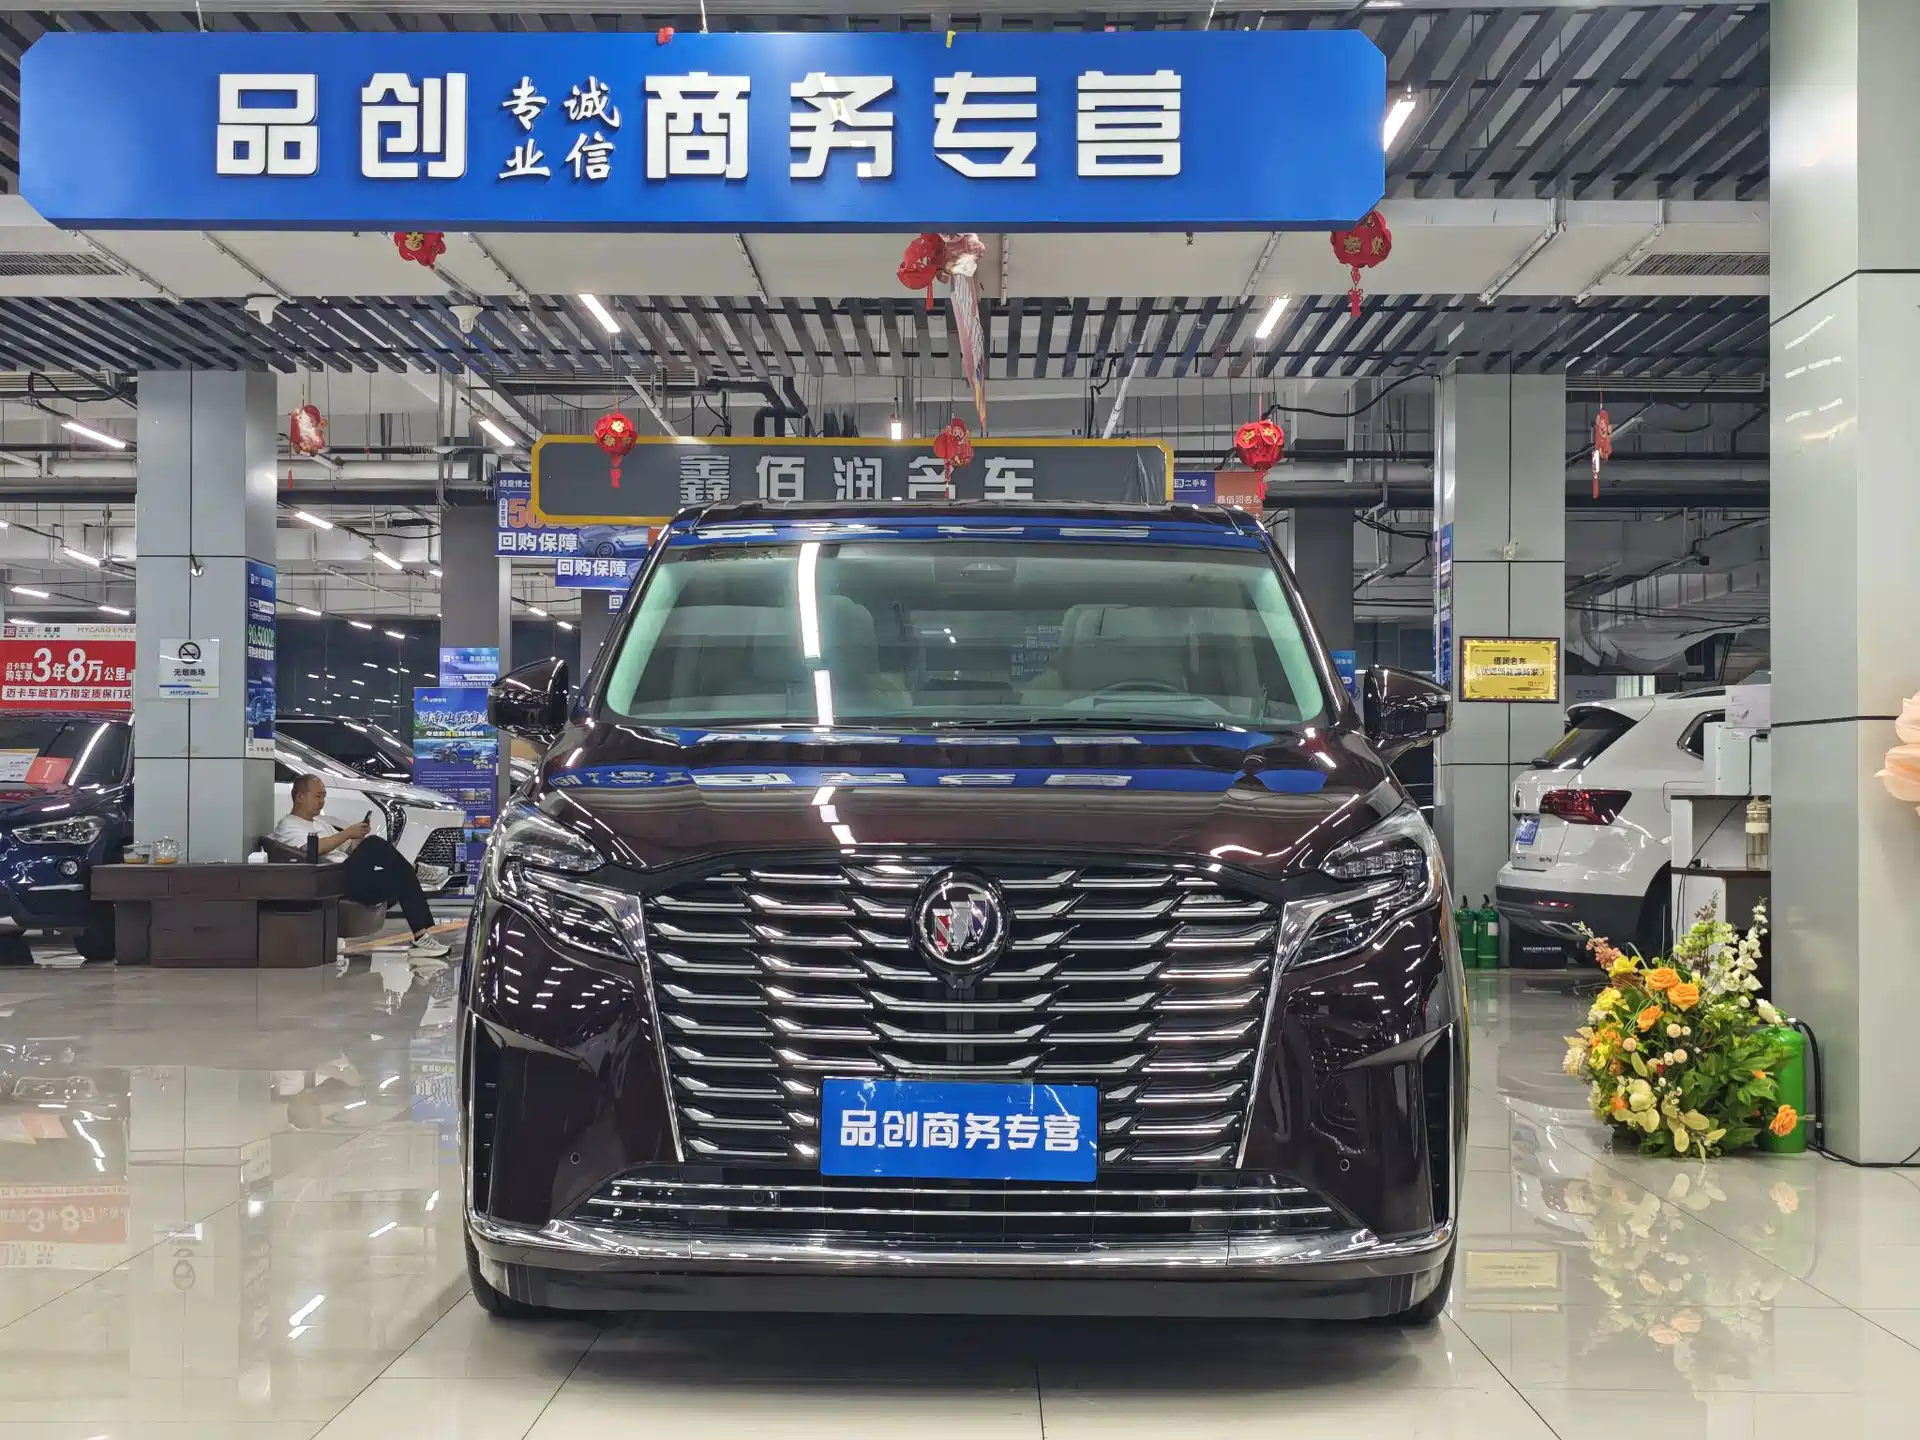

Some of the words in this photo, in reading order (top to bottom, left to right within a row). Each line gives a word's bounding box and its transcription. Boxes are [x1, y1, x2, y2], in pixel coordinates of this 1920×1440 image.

[643, 69, 1183, 180] 商务专营
[679, 454, 1036, 503] 鑫佰润名车
[498, 532, 579, 553] 回购保障
[557, 558, 628, 578] 回购保障
[173, 668, 206, 677] 无烟商场
[839, 1109, 1081, 1153] 品创商务专营
